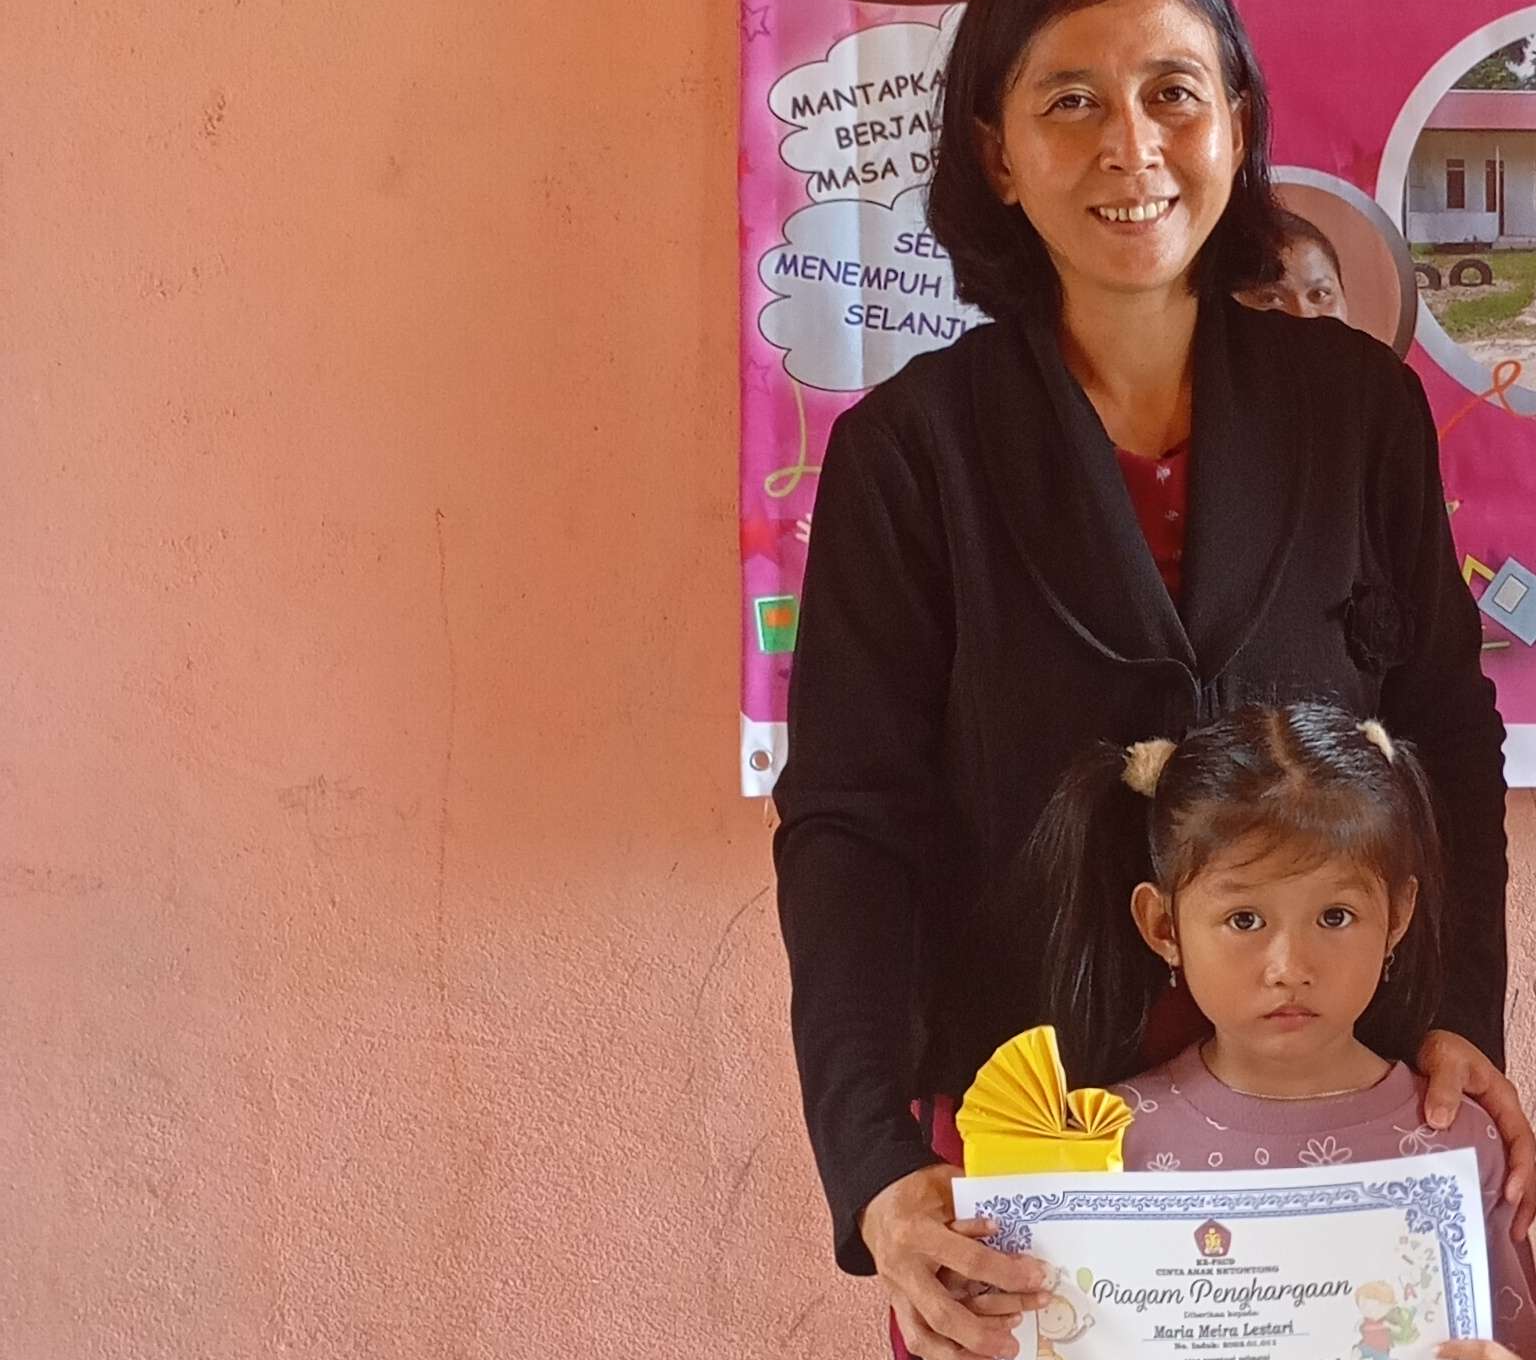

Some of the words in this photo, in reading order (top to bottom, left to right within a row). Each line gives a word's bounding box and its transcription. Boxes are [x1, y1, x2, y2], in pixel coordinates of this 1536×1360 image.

[816, 158, 899, 193] MASA
[774, 252, 942, 299] MENEMPUH
[1155, 1267, 1185, 1277] CINTA
[1092, 1279, 1184, 1313] Piagam
[1190, 1277, 1353, 1311] Penghargaan
[1153, 1324, 1194, 1339] Maria
[1198, 1323, 1239, 1337] Meira
[1243, 1320, 1294, 1337] Lestari
